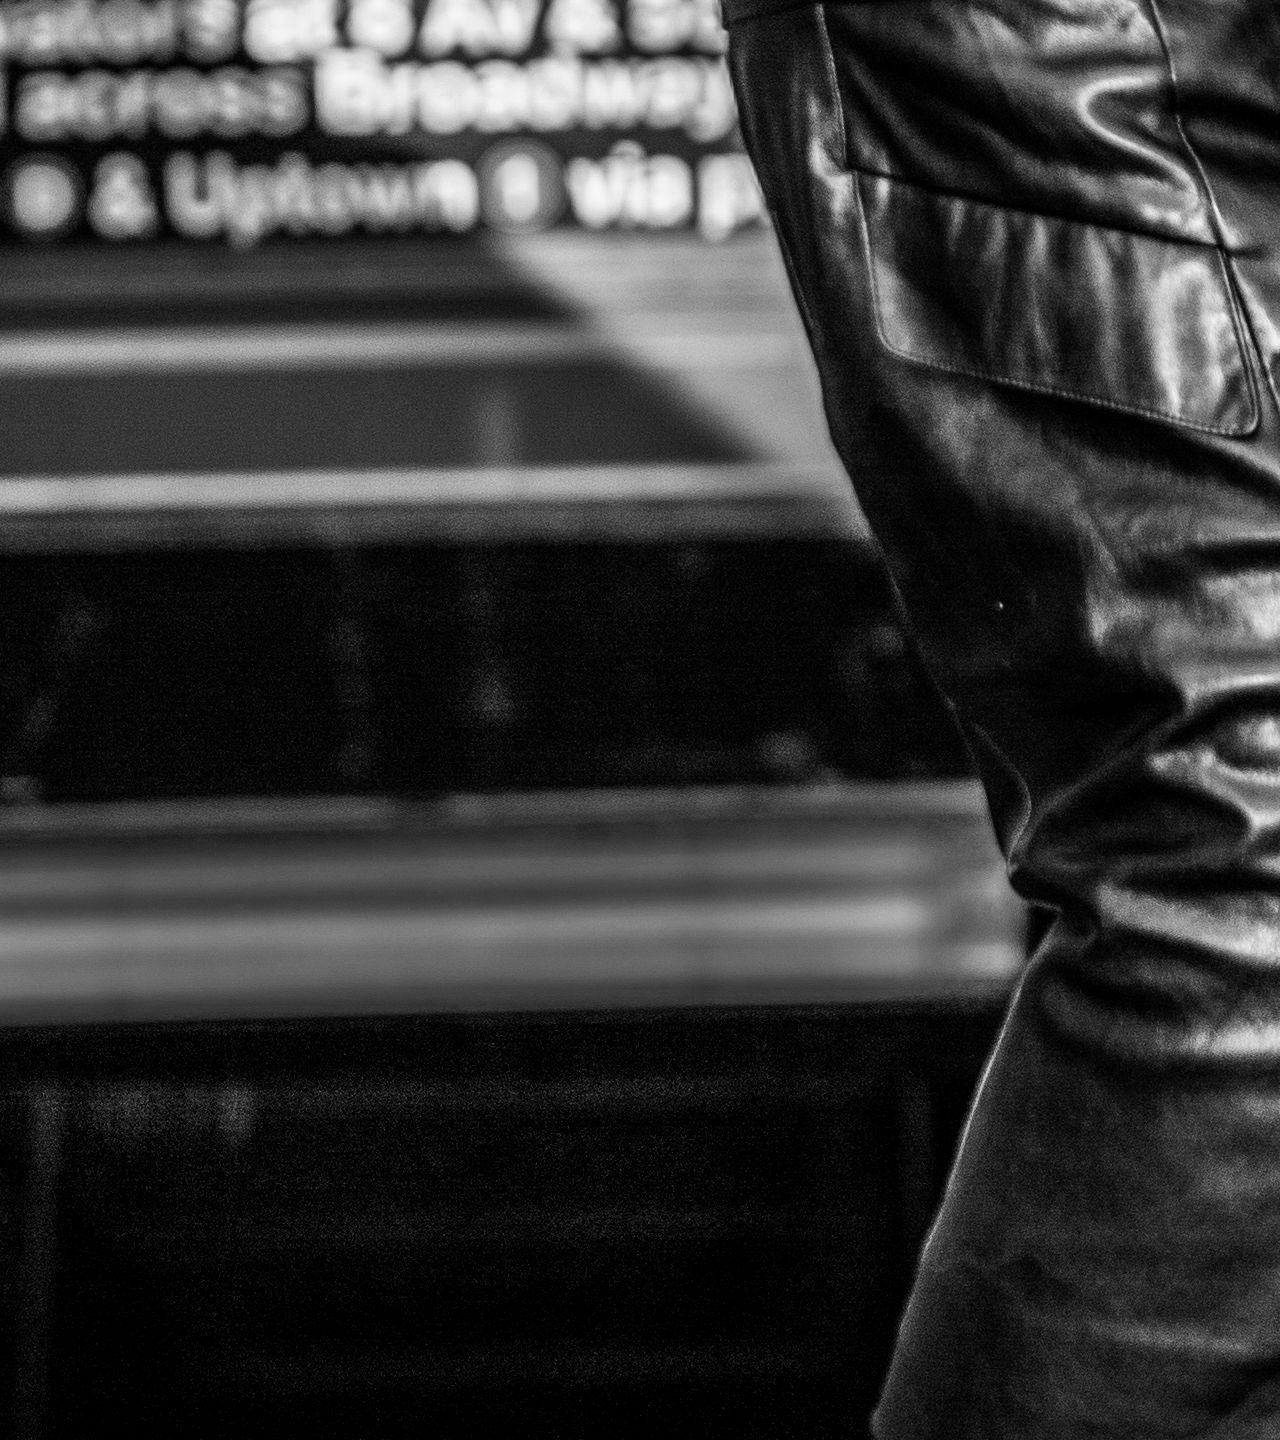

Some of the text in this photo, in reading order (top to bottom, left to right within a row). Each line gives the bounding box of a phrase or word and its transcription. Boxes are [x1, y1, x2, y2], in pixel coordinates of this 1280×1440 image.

[17, 67, 311, 141] across
[314, 46, 734, 143] Broadway
[163, 149, 479, 249] Uptown
[565, 140, 693, 228] via
